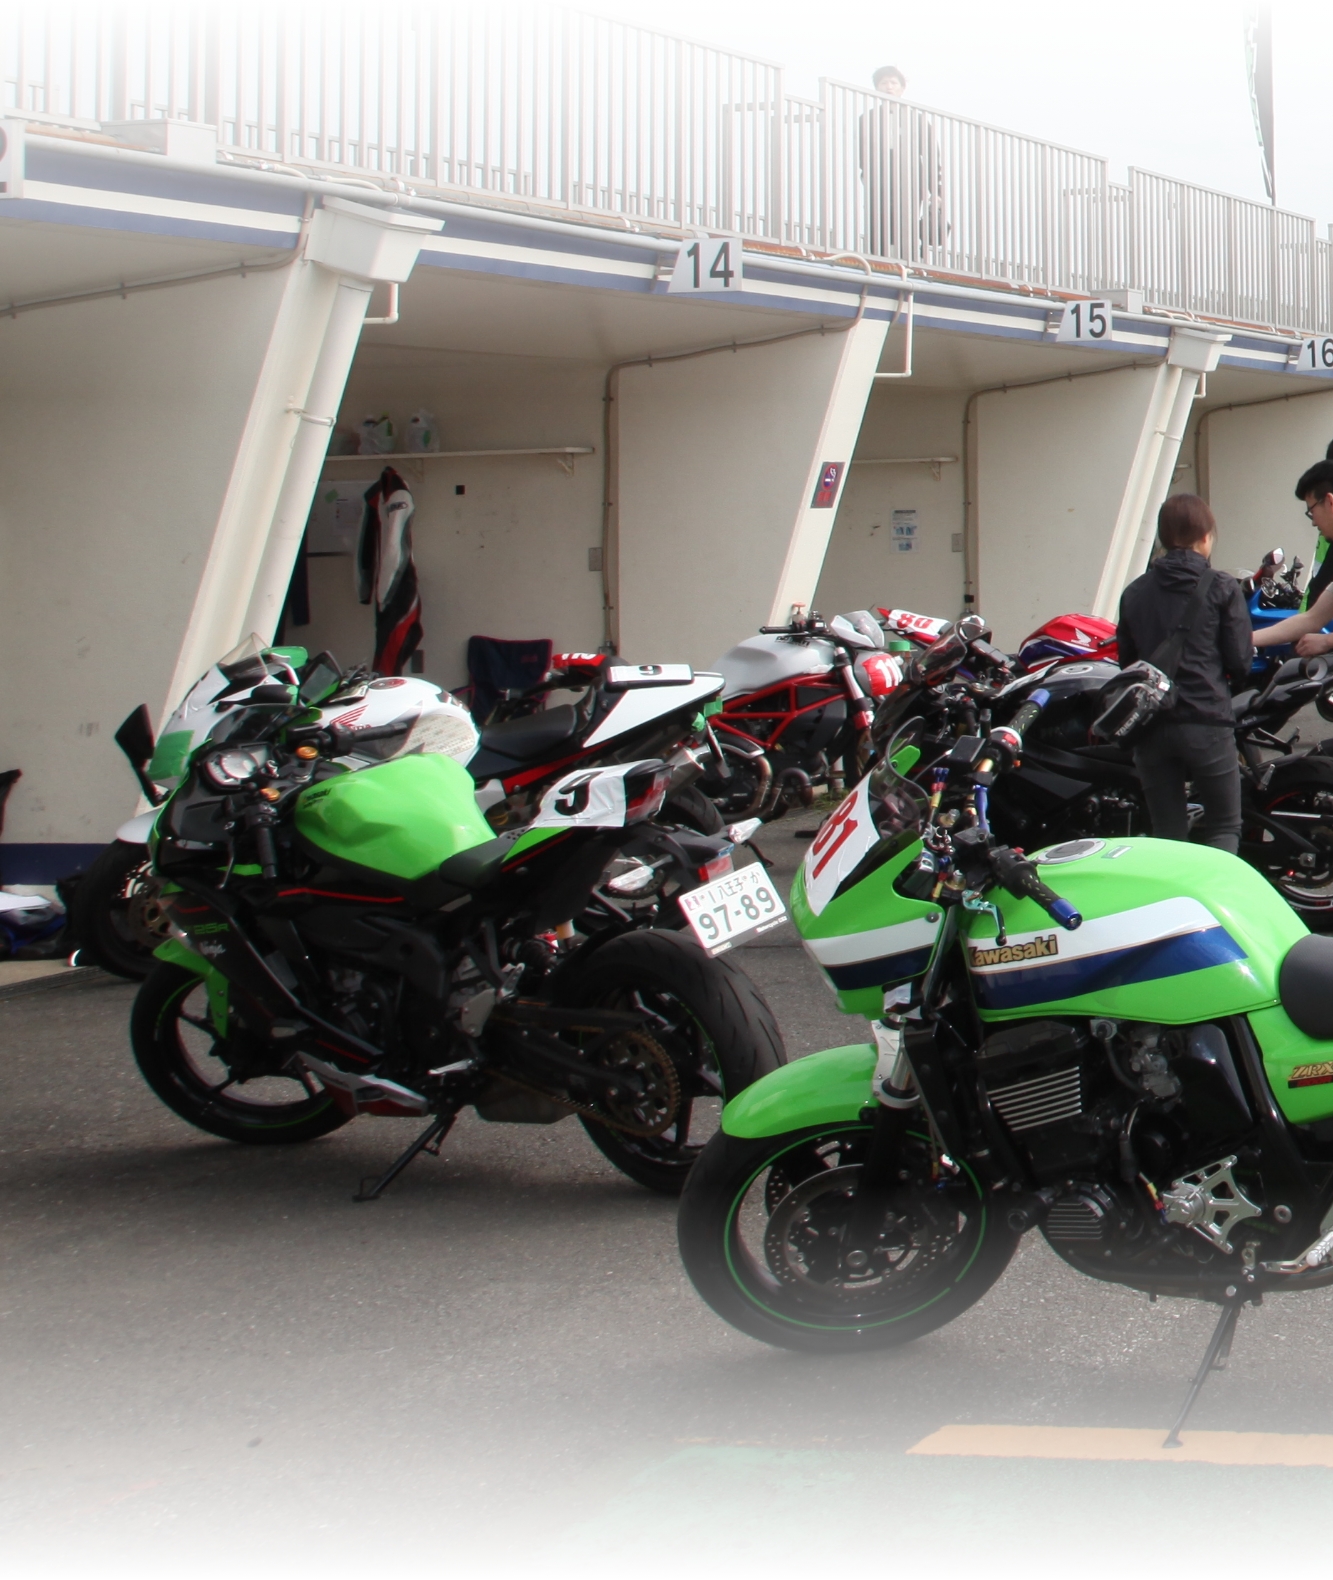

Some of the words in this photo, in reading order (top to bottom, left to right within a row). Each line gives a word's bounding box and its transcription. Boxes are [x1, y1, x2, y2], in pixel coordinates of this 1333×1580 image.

[686, 241, 735, 289] 14
[1070, 302, 1107, 340] 15
[897, 612, 934, 629] 80
[812, 790, 860, 880] 81
[698, 886, 777, 941] 97-89
[968, 934, 1059, 968] Kawasaki
